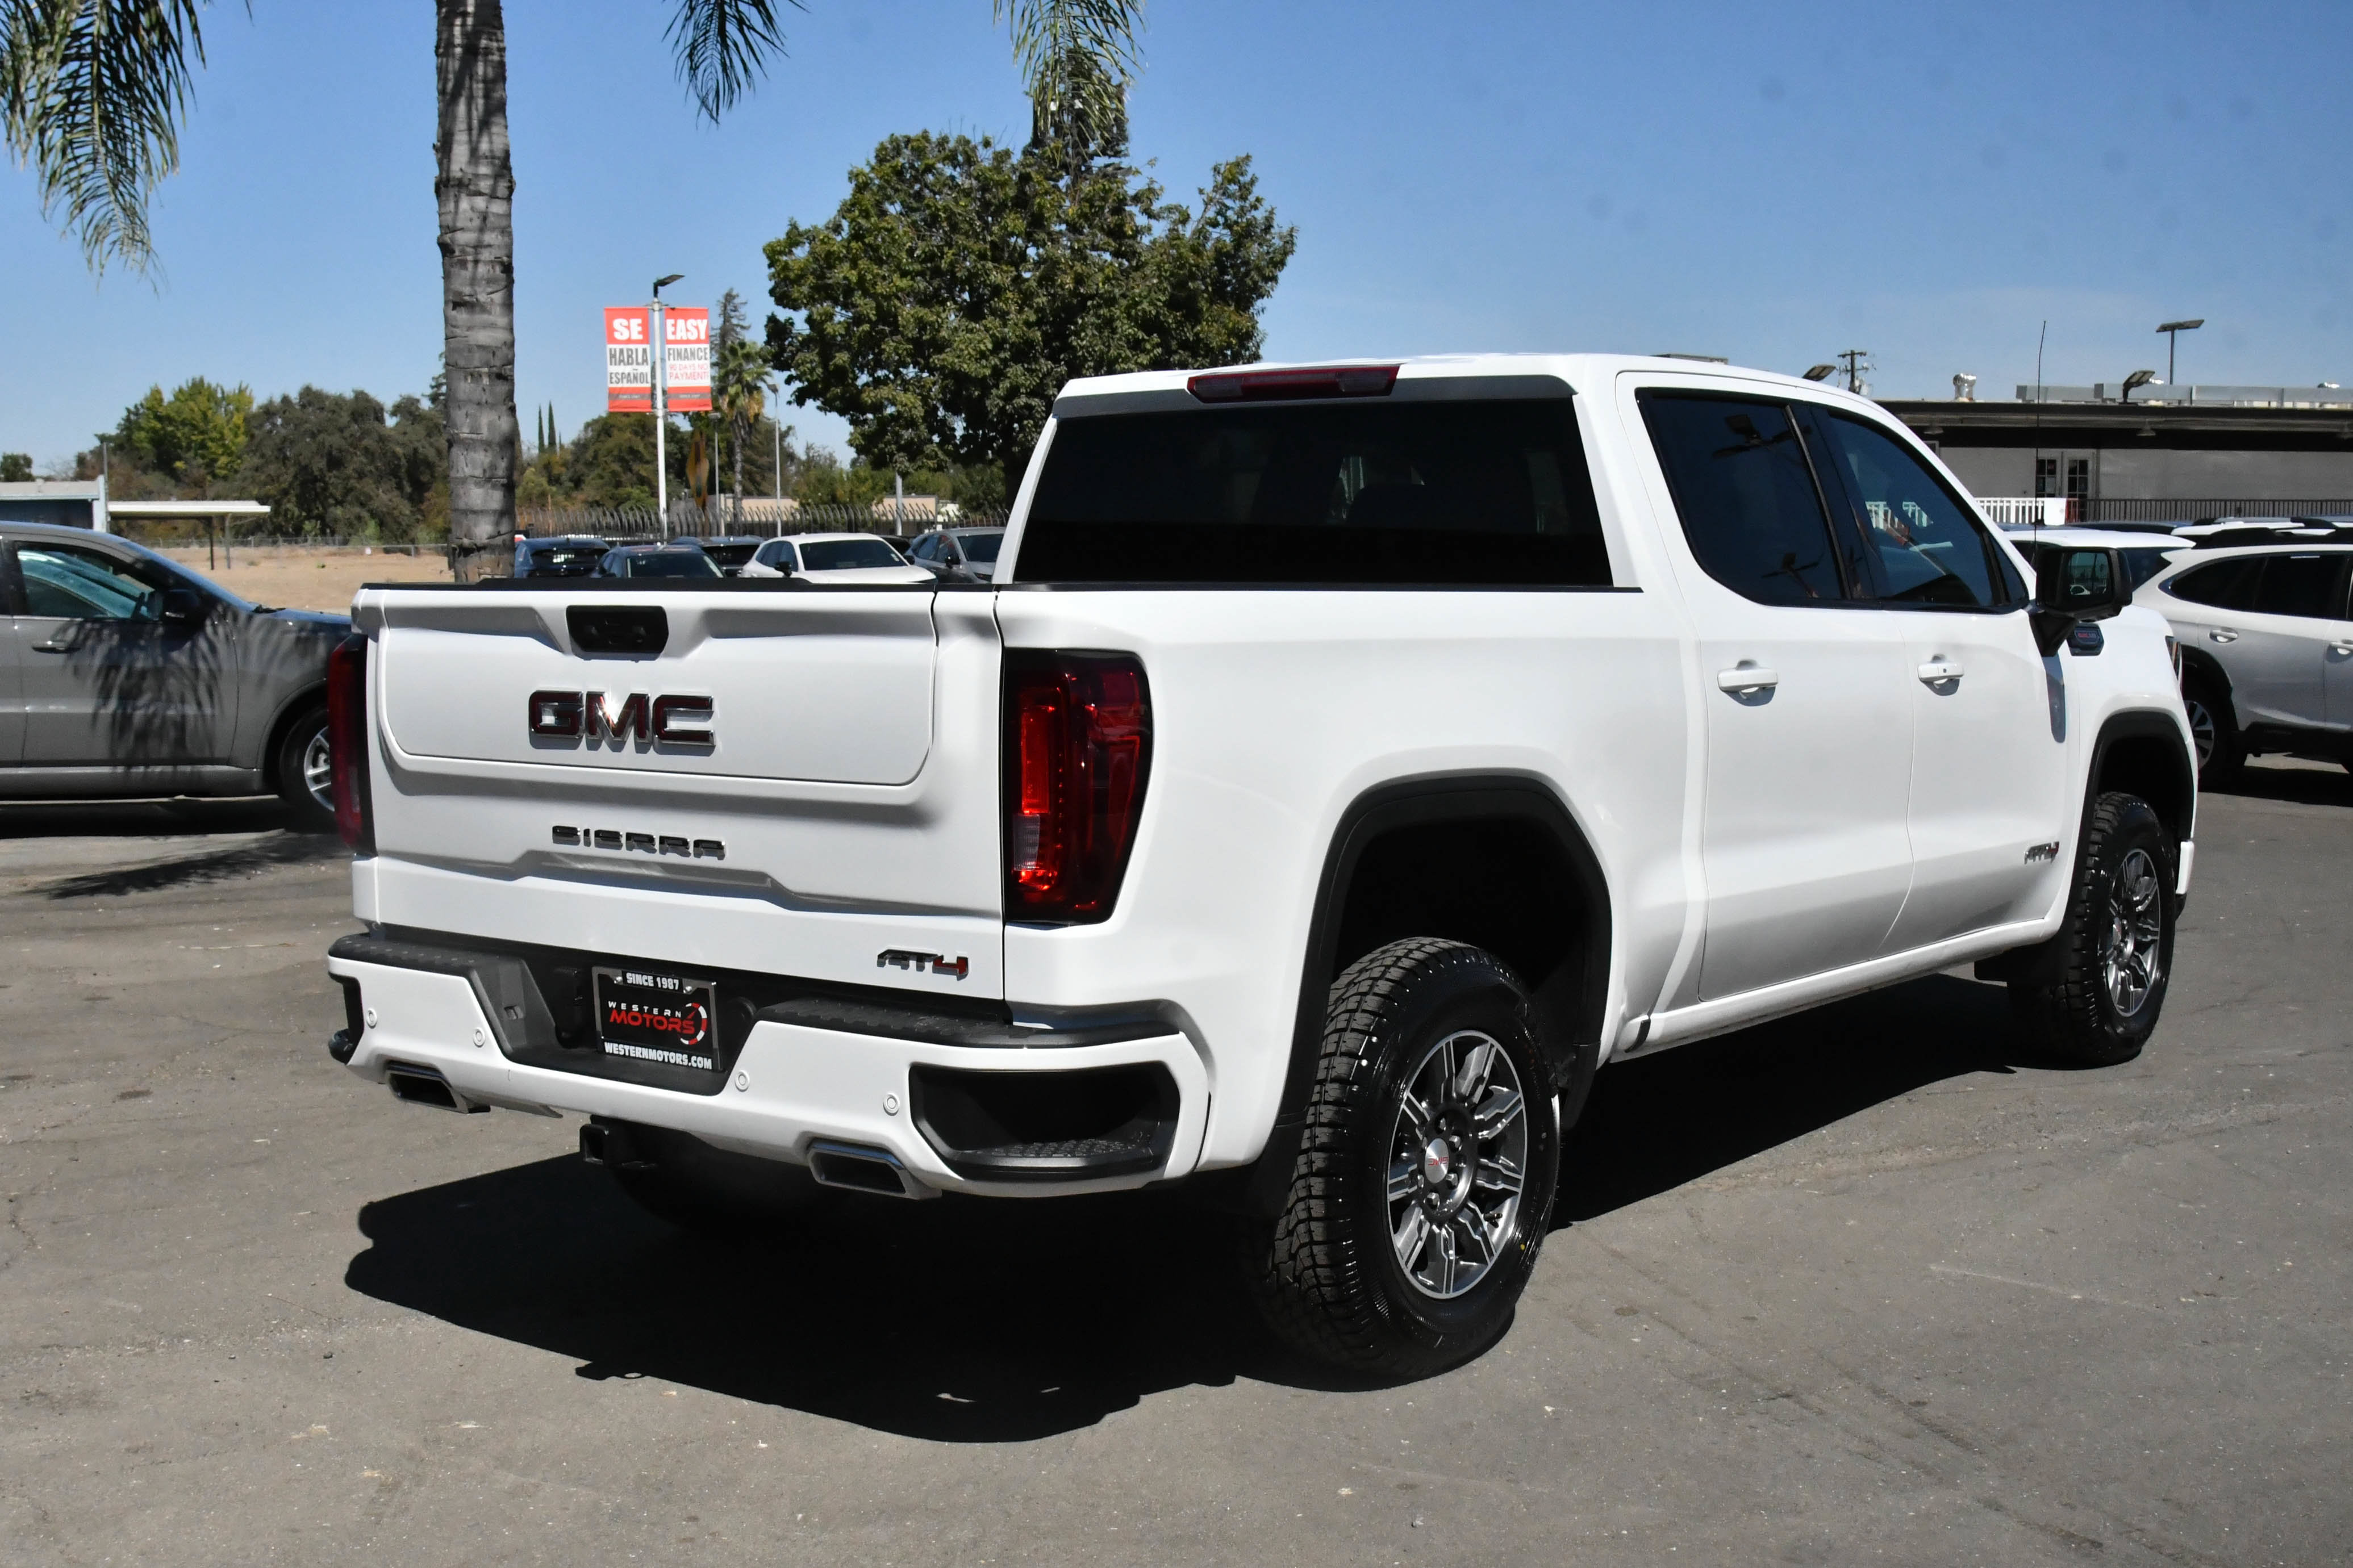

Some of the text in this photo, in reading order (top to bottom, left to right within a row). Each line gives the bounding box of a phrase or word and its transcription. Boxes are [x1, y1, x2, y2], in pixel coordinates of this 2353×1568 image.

[612, 318, 643, 340] SE
[666, 319, 708, 340] EASY
[609, 348, 649, 366] HABLA
[667, 348, 708, 361] FINANCE
[610, 369, 649, 384] ESPAÑOL
[529, 690, 716, 750] GMC
[552, 825, 725, 860] SIERRA
[877, 949, 969, 979] AT4
[626, 972, 679, 990] SINCE 1987
[608, 1001, 682, 1018] WESTERN
[609, 1009, 695, 1034] MOTORS
[604, 1042, 712, 1070] WESTERNMOTORS.COM
[1428, 1156, 1449, 1166] GMC
